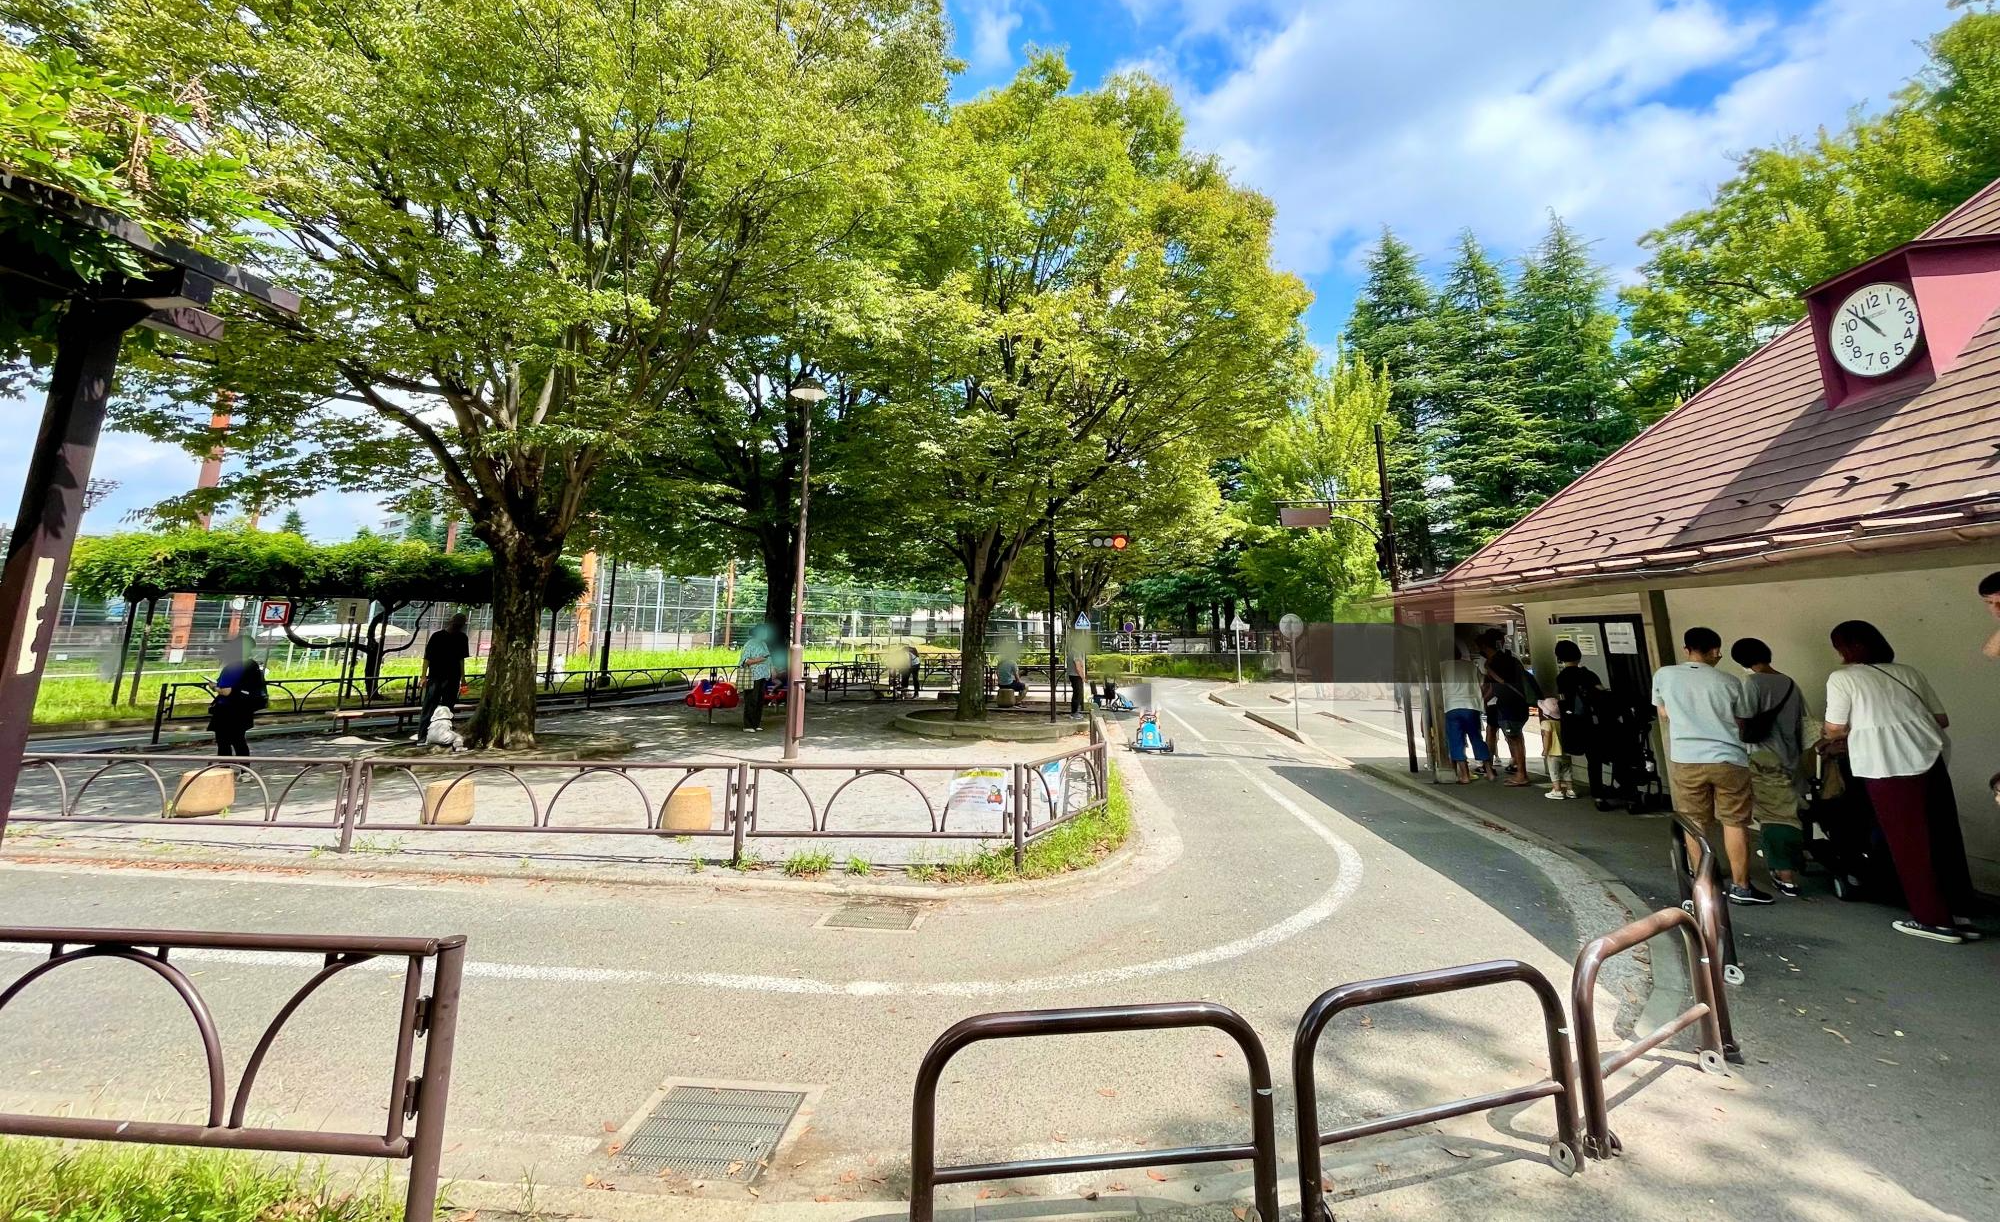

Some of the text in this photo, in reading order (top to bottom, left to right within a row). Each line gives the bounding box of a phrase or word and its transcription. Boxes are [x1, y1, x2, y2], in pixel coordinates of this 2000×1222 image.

[1866, 295, 1880, 309] 12
[1886, 293, 1890, 305] 1
[1896, 298, 1907, 311] 2
[1904, 311, 1915, 324] 3
[1845, 319, 1857, 333] 10
[1904, 327, 1914, 339] 4
[1845, 336, 1854, 347] 9
[1852, 346, 1862, 358] 8
[1894, 342, 1904, 355] 5
[1865, 353, 1874, 366] 7
[1880, 352, 1890, 364] 6
